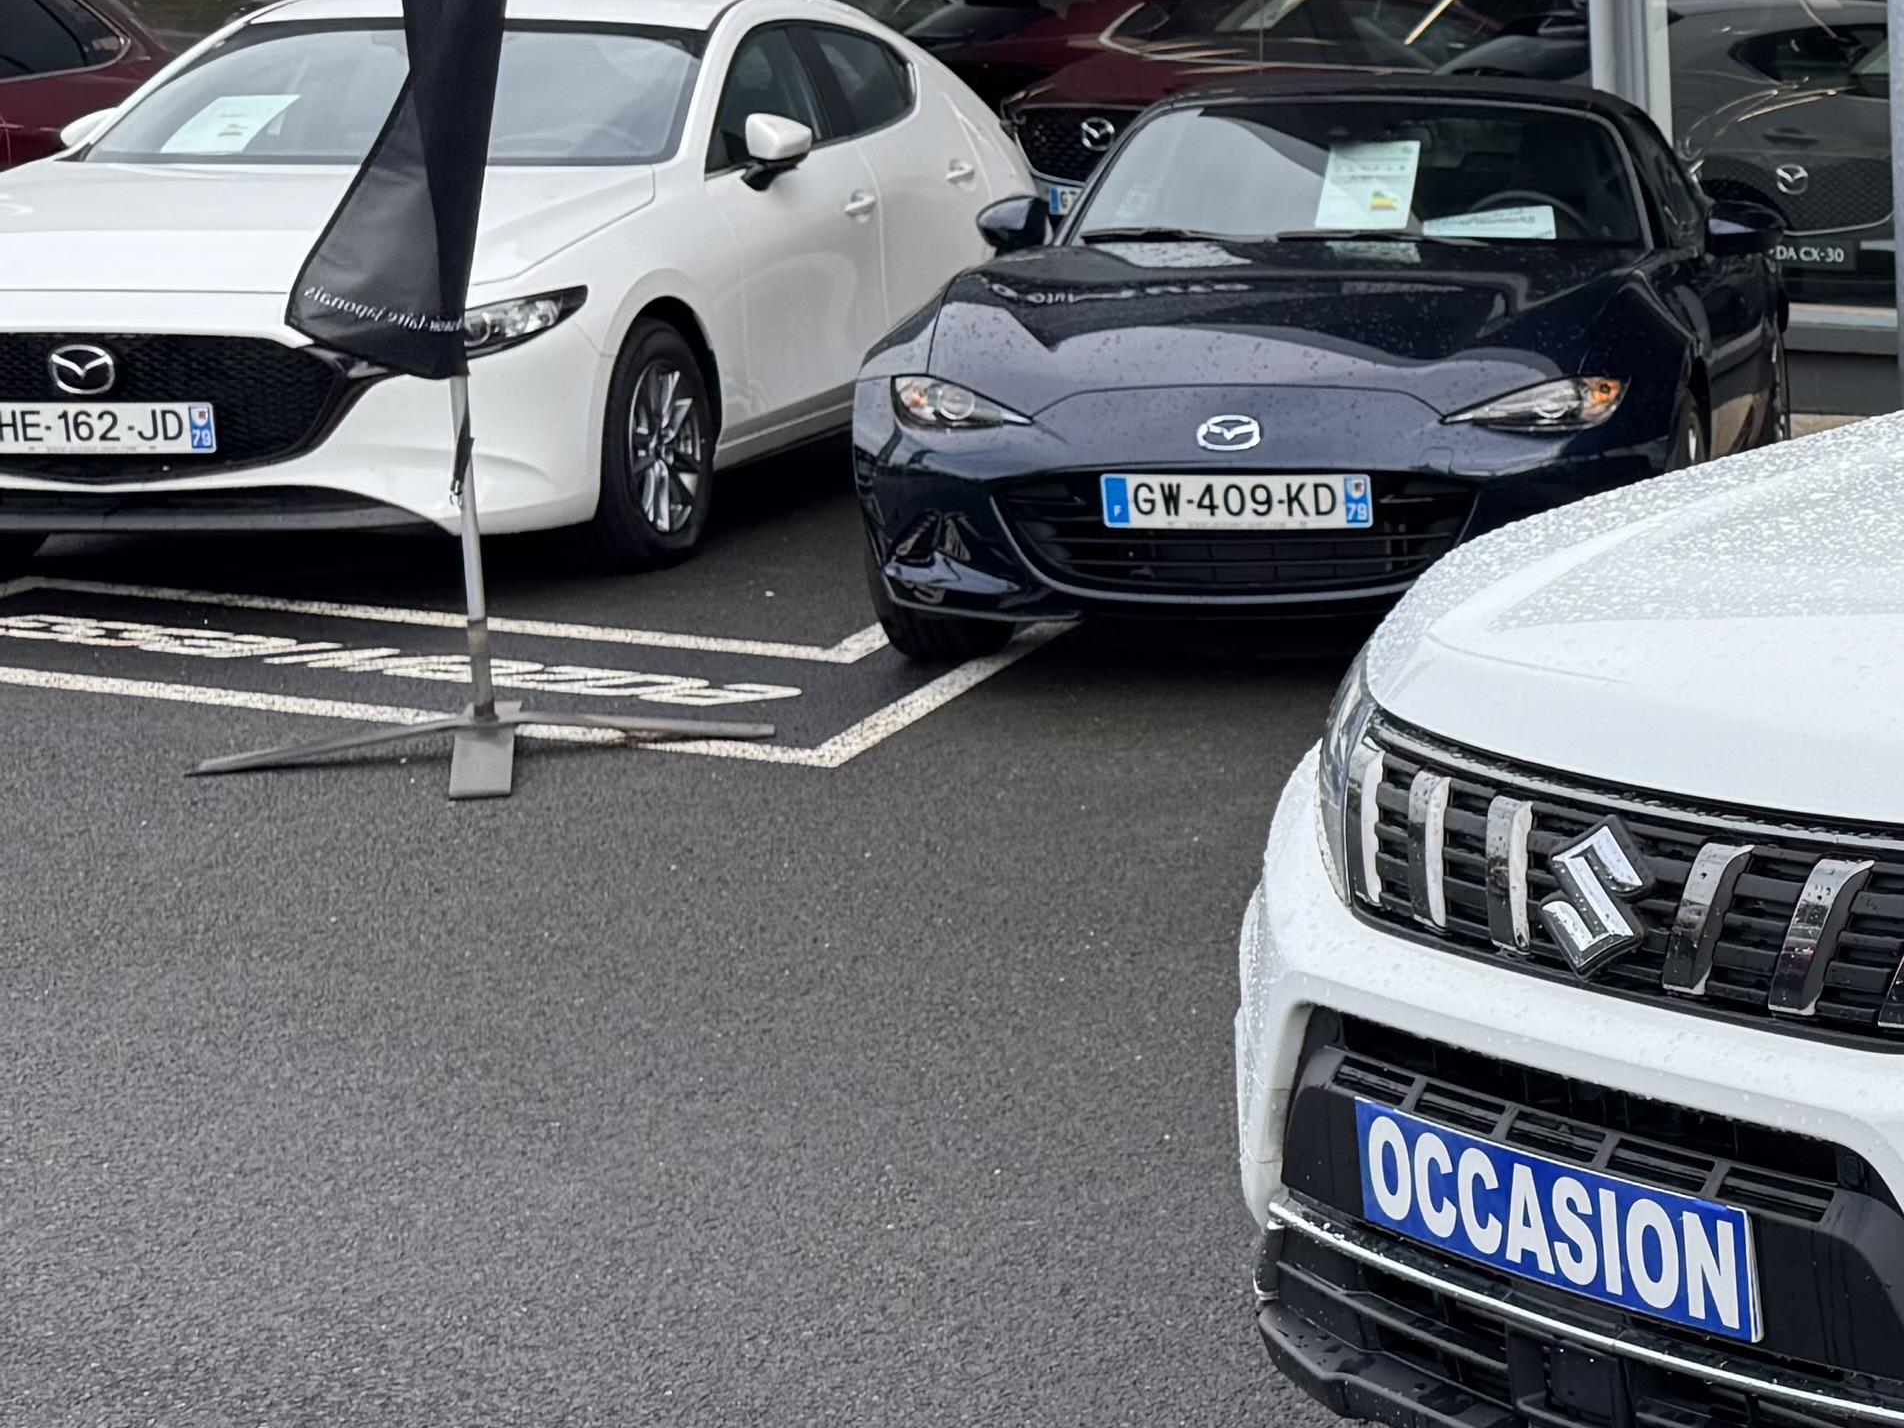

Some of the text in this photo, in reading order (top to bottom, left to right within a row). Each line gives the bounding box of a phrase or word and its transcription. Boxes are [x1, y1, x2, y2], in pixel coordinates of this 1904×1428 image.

[1799, 246, 1845, 262] CX-30
[0, 409, 184, 443] HE-162-JD
[1132, 481, 1337, 517] GW-409-KD
[1366, 1113, 1741, 1331] OCCASION
